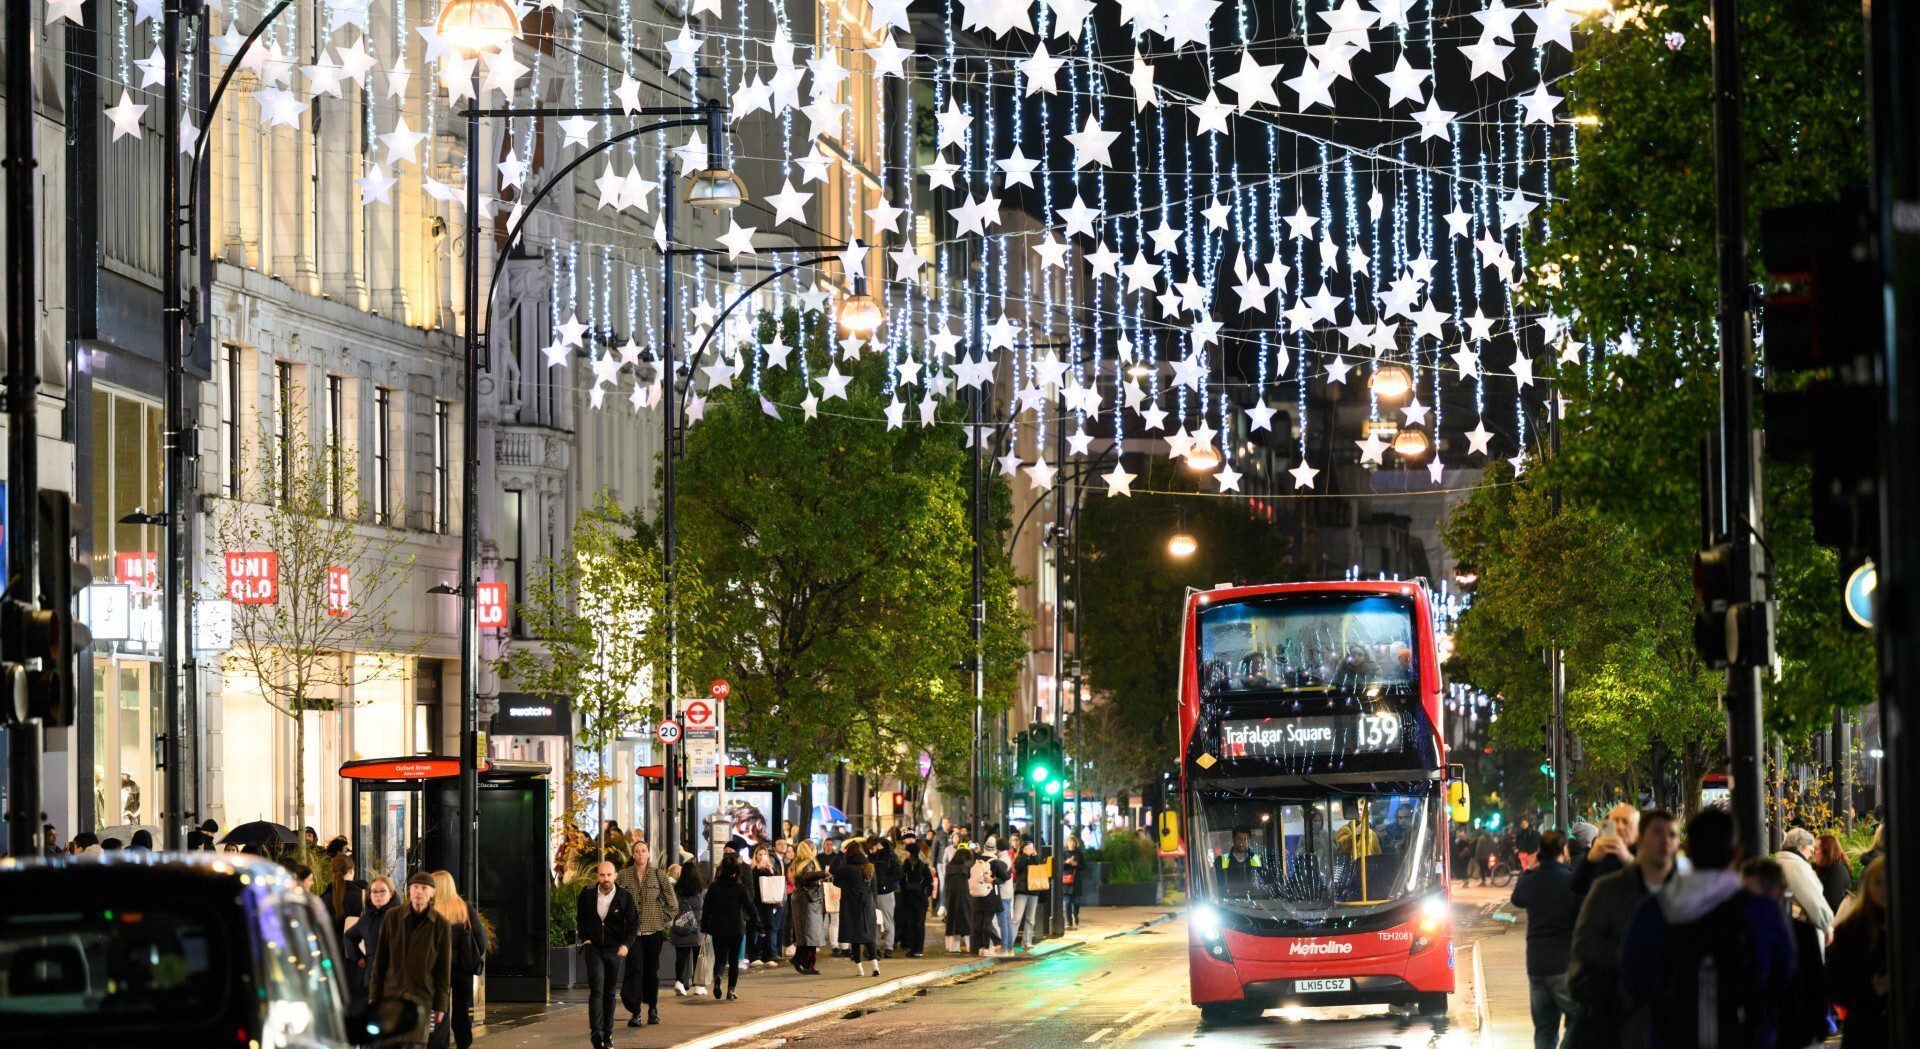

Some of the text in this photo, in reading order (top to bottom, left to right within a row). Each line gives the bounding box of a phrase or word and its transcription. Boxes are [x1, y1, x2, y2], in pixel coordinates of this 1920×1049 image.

[230, 557, 268, 577] UNI
[230, 579, 272, 599] QLO
[479, 587, 498, 602] NI
[479, 606, 502, 622] LO
[712, 685, 728, 694] OR
[660, 727, 677, 737] 20
[1224, 724, 1331, 747] Trafalgar Square
[1357, 715, 1399, 746] 139
[1378, 931, 1413, 941] TEH2081
[1289, 940, 1353, 955] Metroline
[1301, 979, 1345, 991] LK15 CSZ
